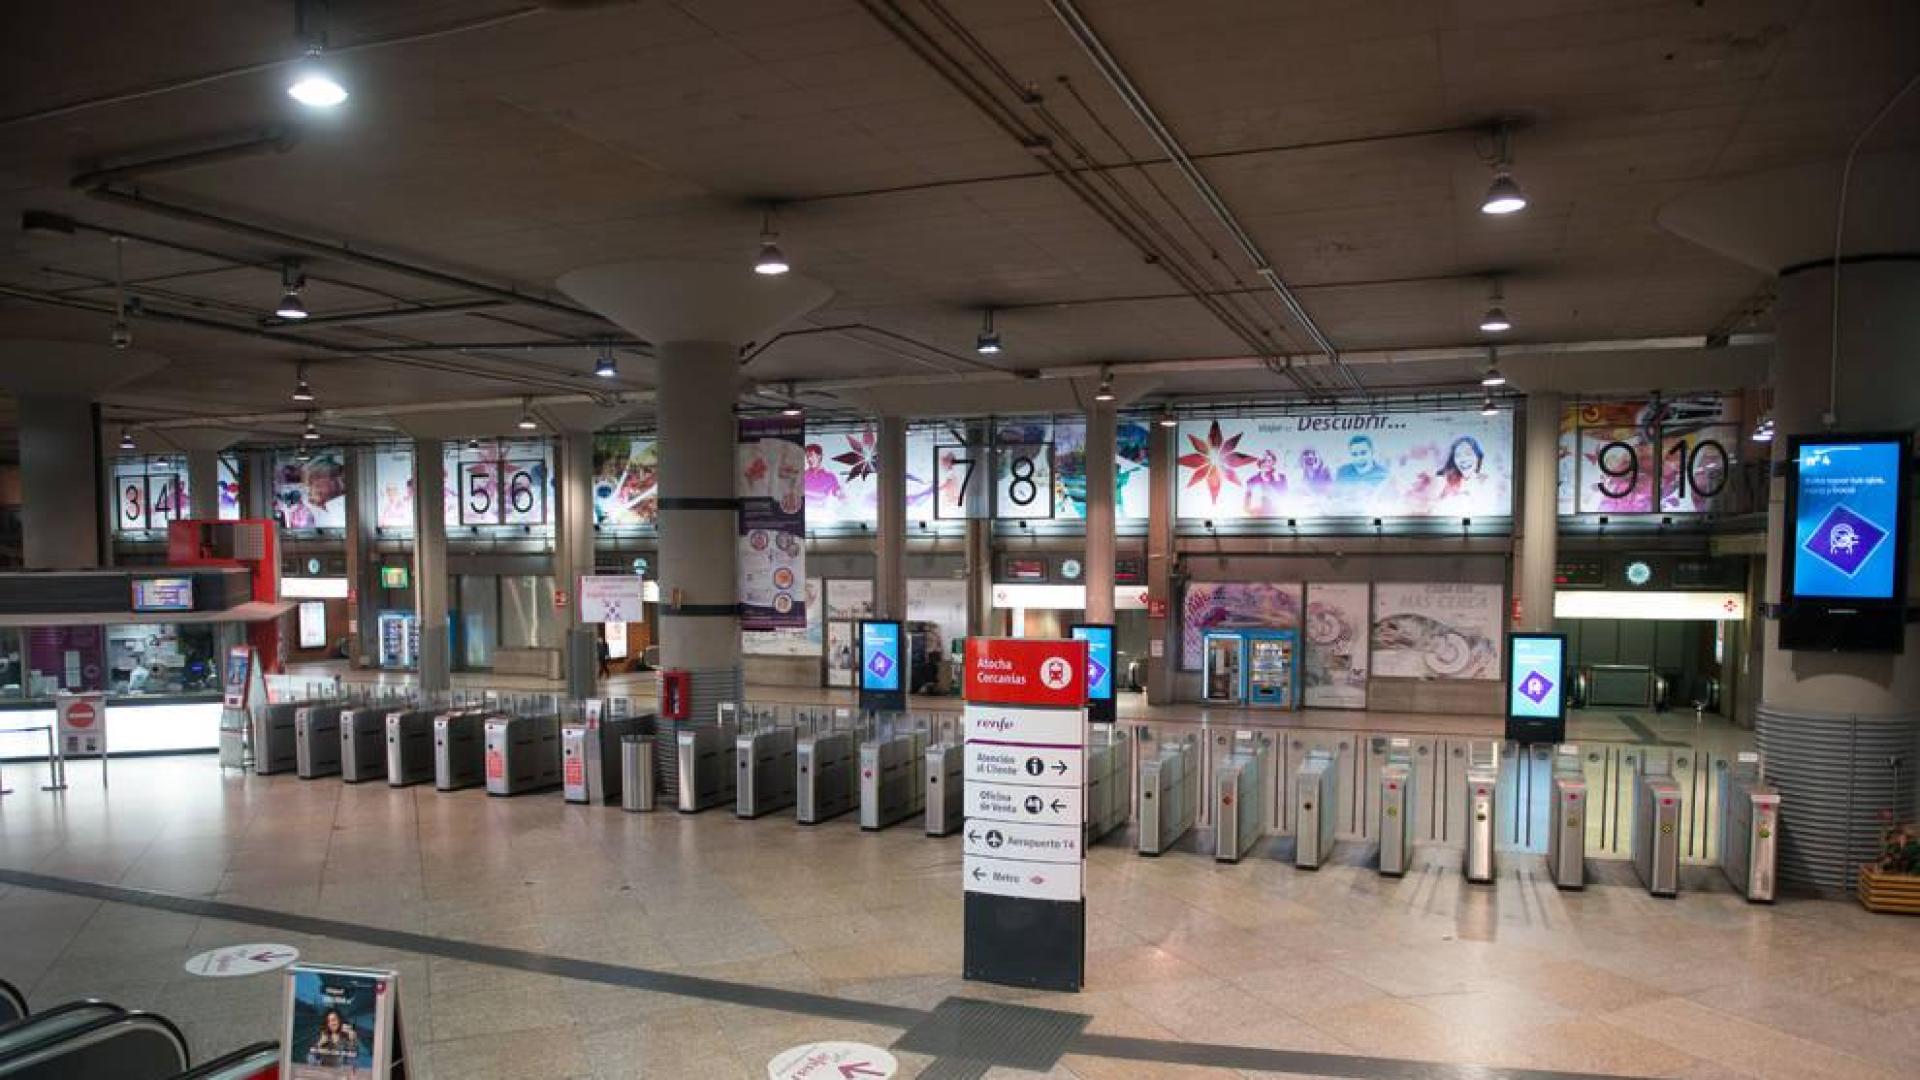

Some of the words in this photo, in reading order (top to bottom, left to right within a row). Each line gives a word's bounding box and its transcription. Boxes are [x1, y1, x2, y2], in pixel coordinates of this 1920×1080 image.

[1297, 415, 1407, 431] Descubrir...
[1599, 441, 1638, 497] 9
[1669, 440, 1729, 498] 10
[950, 459, 976, 507] 7
[1009, 457, 1037, 506] 8
[470, 474, 490, 514] 5
[511, 471, 534, 513] 6
[125, 484, 141, 521] 3
[154, 483, 172, 520] 4
[977, 657, 1013, 671] Atocha
[977, 671, 1027, 686] Cercanías
[977, 716, 1014, 731] renfe
[976, 752, 1016, 765] Atención
[986, 764, 1017, 775] Cliente
[979, 790, 1012, 802] Oficina
[991, 802, 1017, 814] Venta
[1006, 836, 1061, 849] Aeropuerto
[992, 871, 1021, 884] Metro
